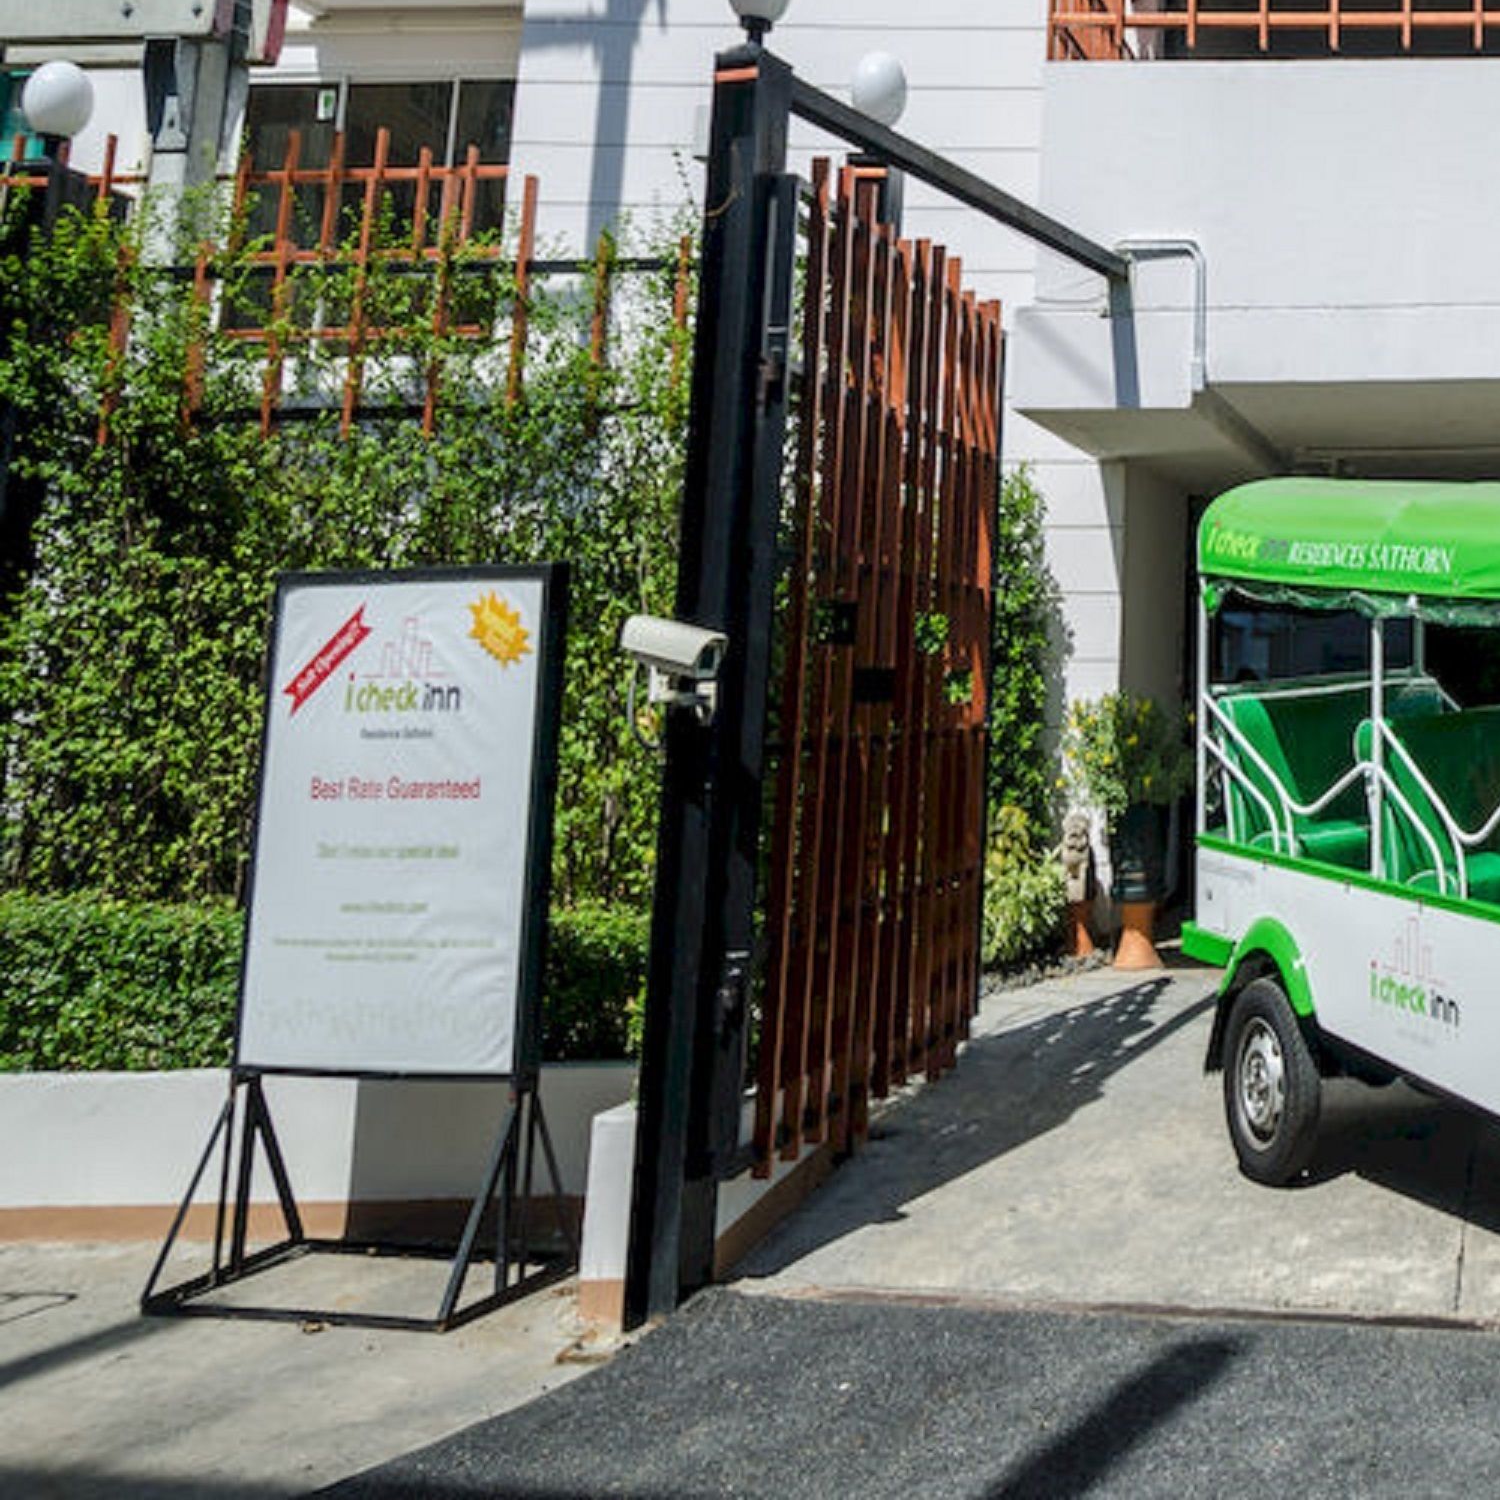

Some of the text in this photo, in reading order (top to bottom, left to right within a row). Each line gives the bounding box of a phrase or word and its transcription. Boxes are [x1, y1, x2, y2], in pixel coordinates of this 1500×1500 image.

[1367, 542, 1455, 575] SATHORN
[310, 775, 481, 800] Best Rate Guaranteed
